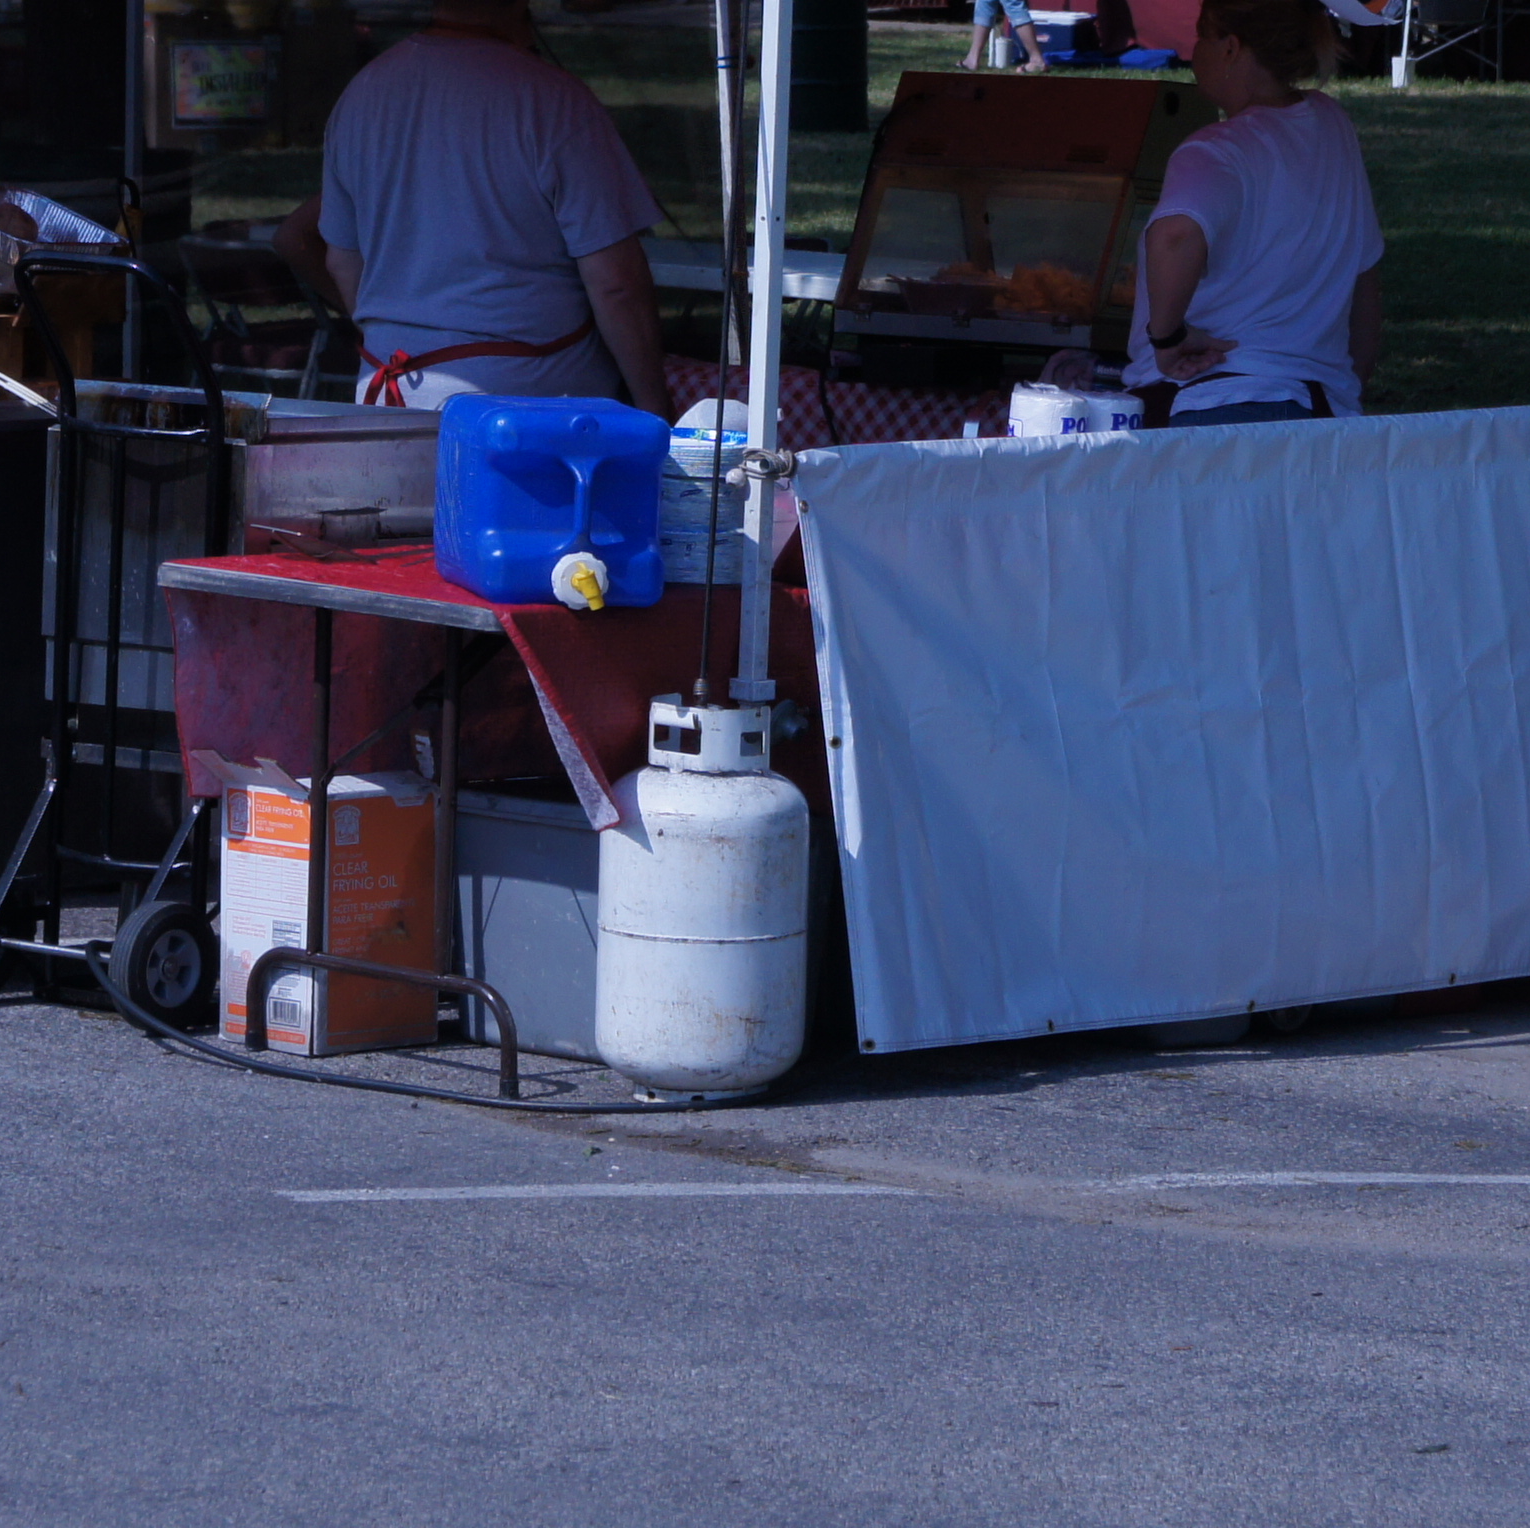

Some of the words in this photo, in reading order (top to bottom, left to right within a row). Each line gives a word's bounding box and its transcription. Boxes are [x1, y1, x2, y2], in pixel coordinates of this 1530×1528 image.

[332, 860, 368, 876] CLEAR
[332, 876, 375, 892] FRYING
[378, 875, 398, 889] OIL
